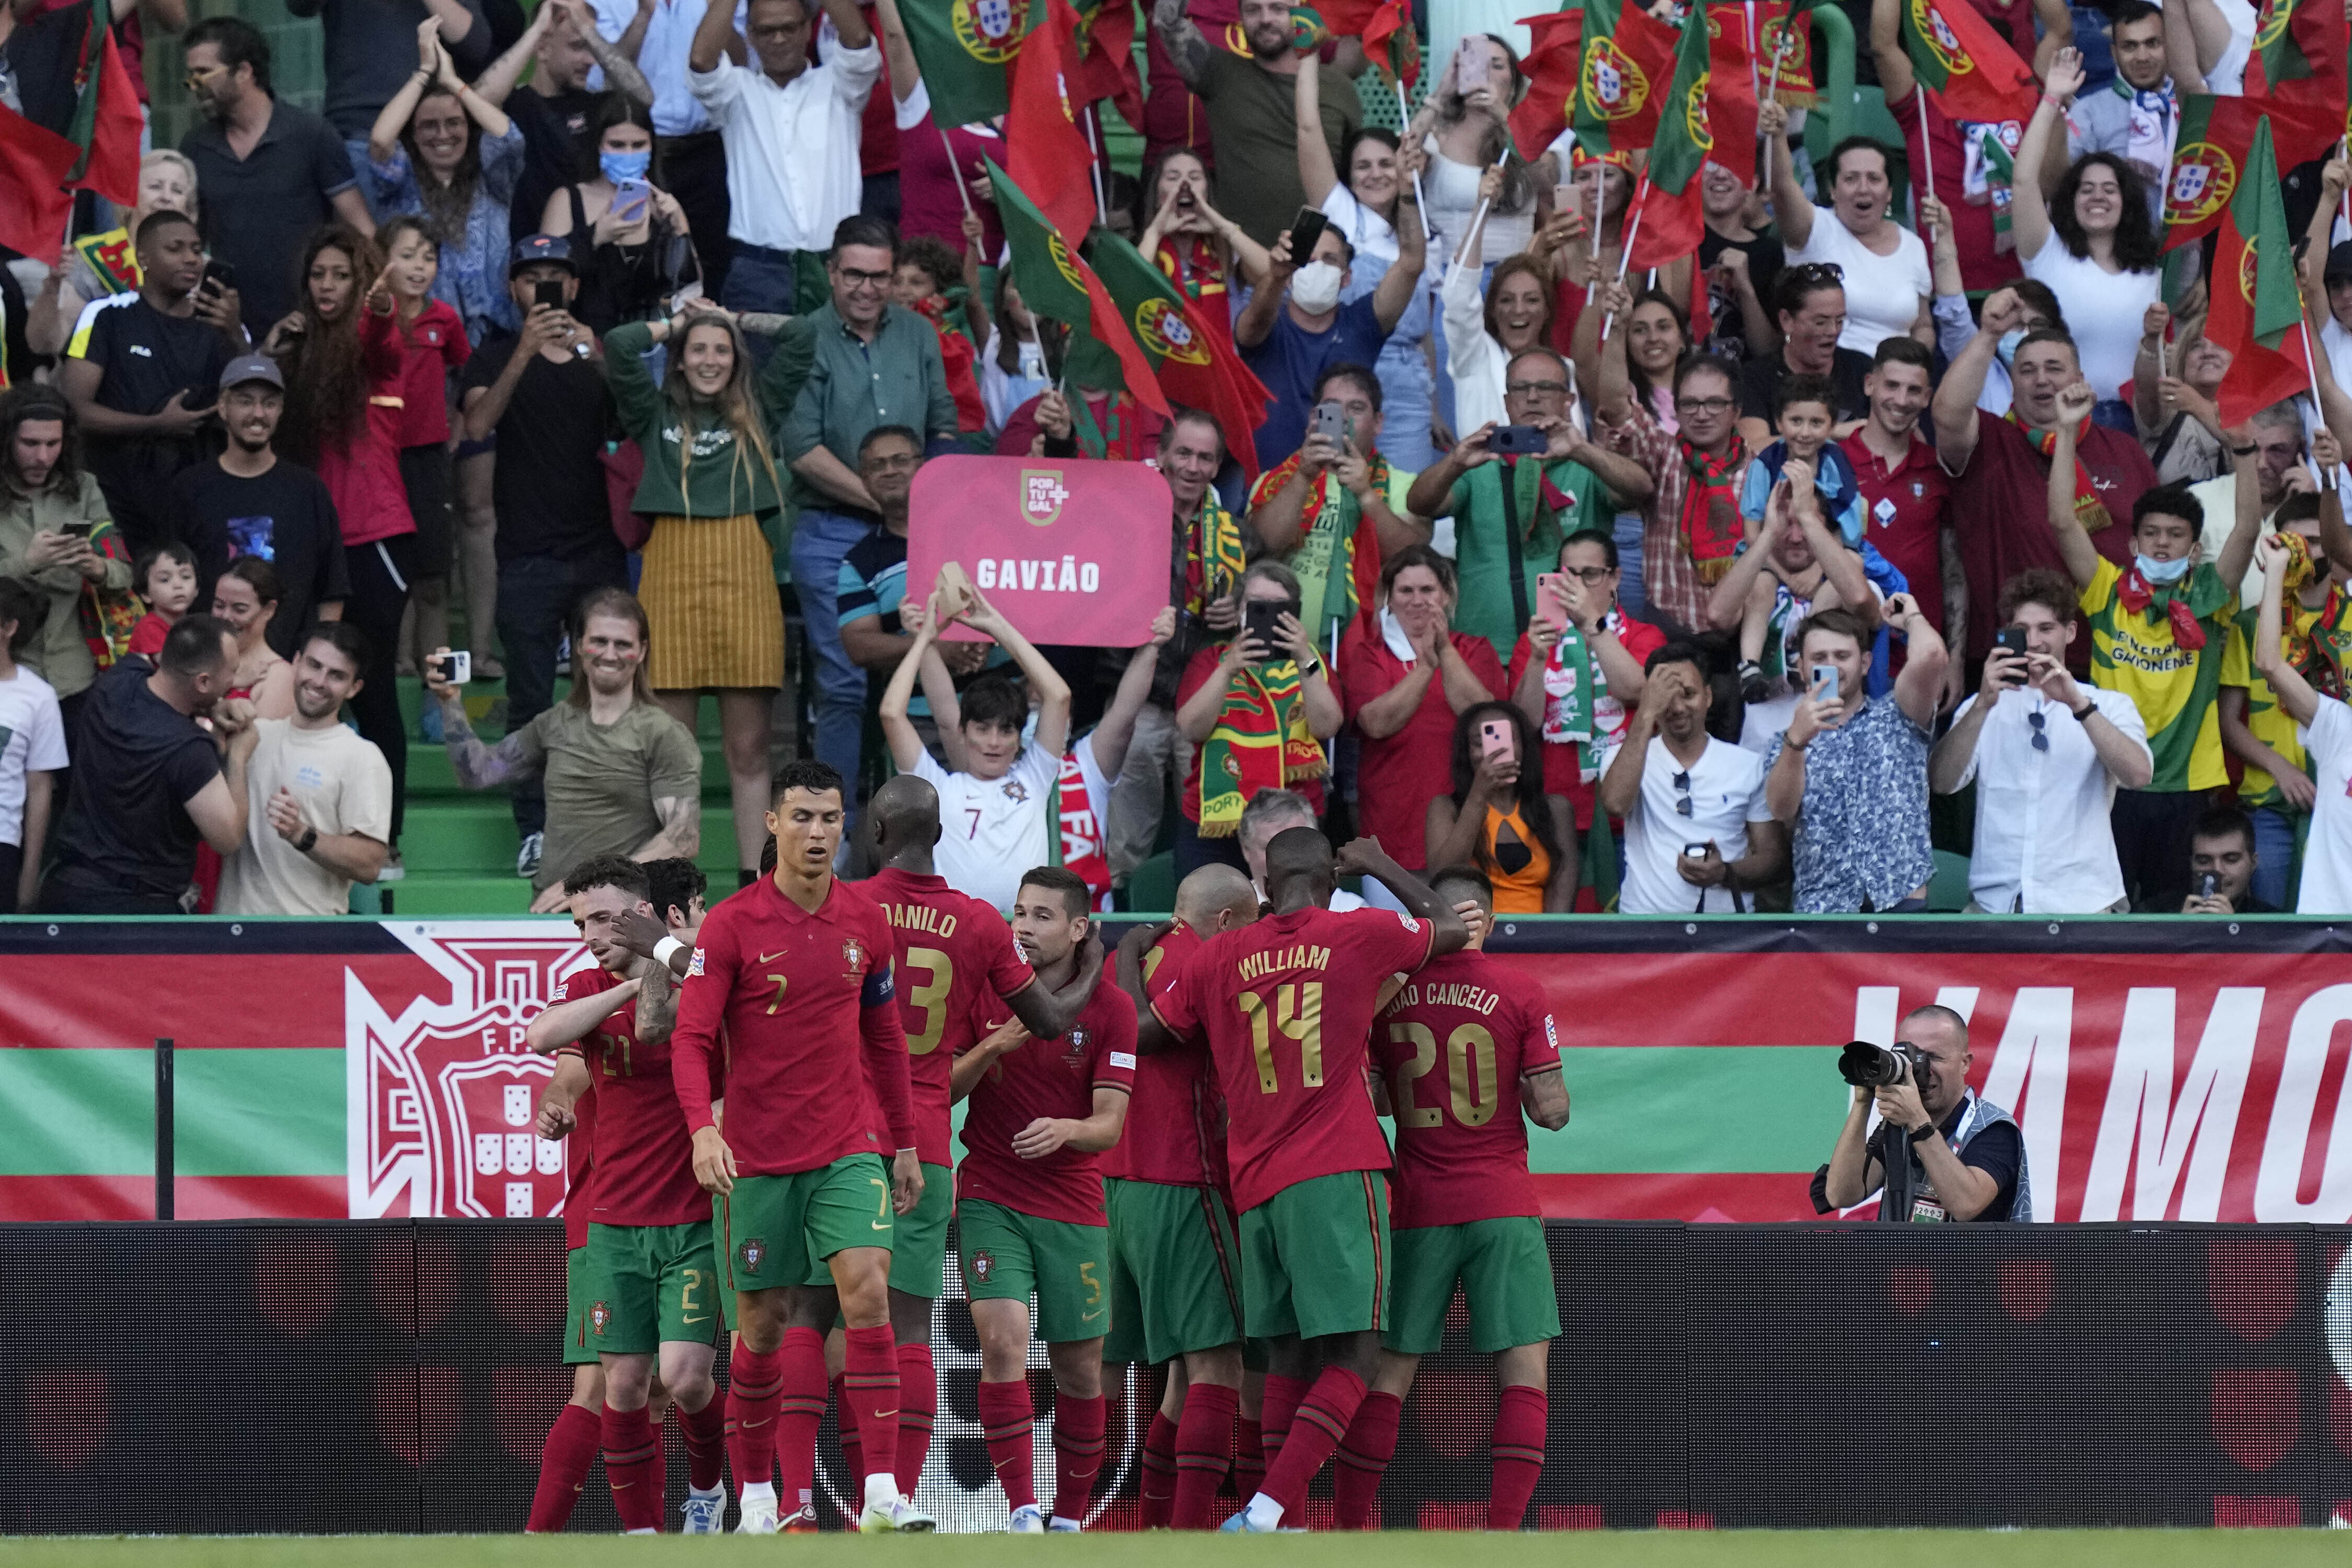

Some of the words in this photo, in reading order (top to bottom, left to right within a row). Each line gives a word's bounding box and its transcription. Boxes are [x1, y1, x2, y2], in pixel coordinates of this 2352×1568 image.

[1029, 477, 1054, 489] POR
[1029, 489, 1046, 500] TU
[1028, 501, 1053, 512] GAL
[977, 554, 1100, 593] GAVIÃO
[964, 808, 982, 840] 7
[879, 903, 957, 938] DANILO
[1238, 944, 1331, 982] WILLIAM
[767, 974, 788, 1015] 7
[1426, 983, 1500, 1016] CANCELO
[601, 1034, 632, 1077] 21
[1238, 982, 1323, 1094] 14
[1389, 1022, 1498, 1128] 20
[870, 1179, 887, 1217] 7
[1080, 1261, 1101, 1305] 5
